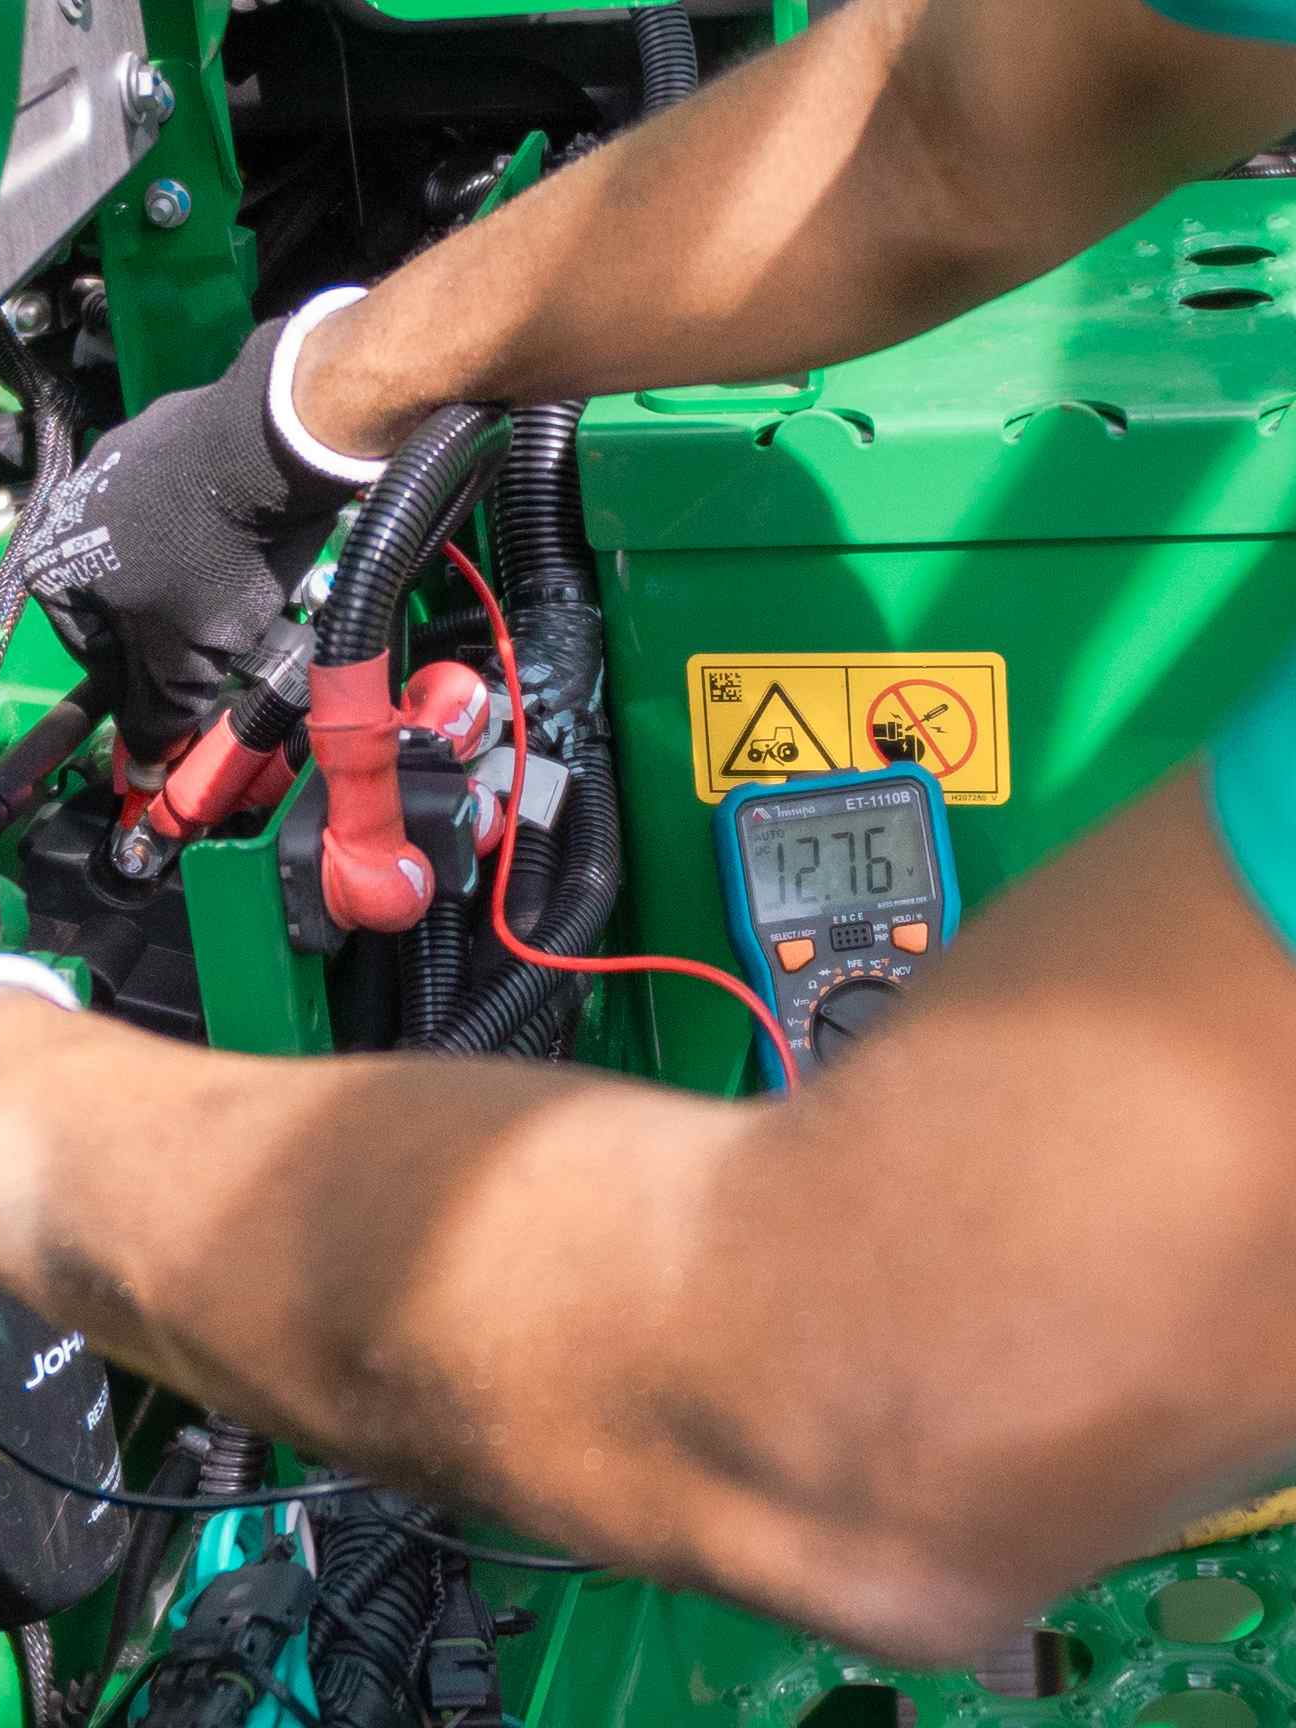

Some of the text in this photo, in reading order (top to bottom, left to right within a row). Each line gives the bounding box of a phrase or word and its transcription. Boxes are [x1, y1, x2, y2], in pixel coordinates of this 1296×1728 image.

[846, 791, 911, 810] ET-1110B
[777, 826, 893, 904] 12.76
[892, 965, 912, 977] NCV
[25, 1329, 86, 1390] JOH
